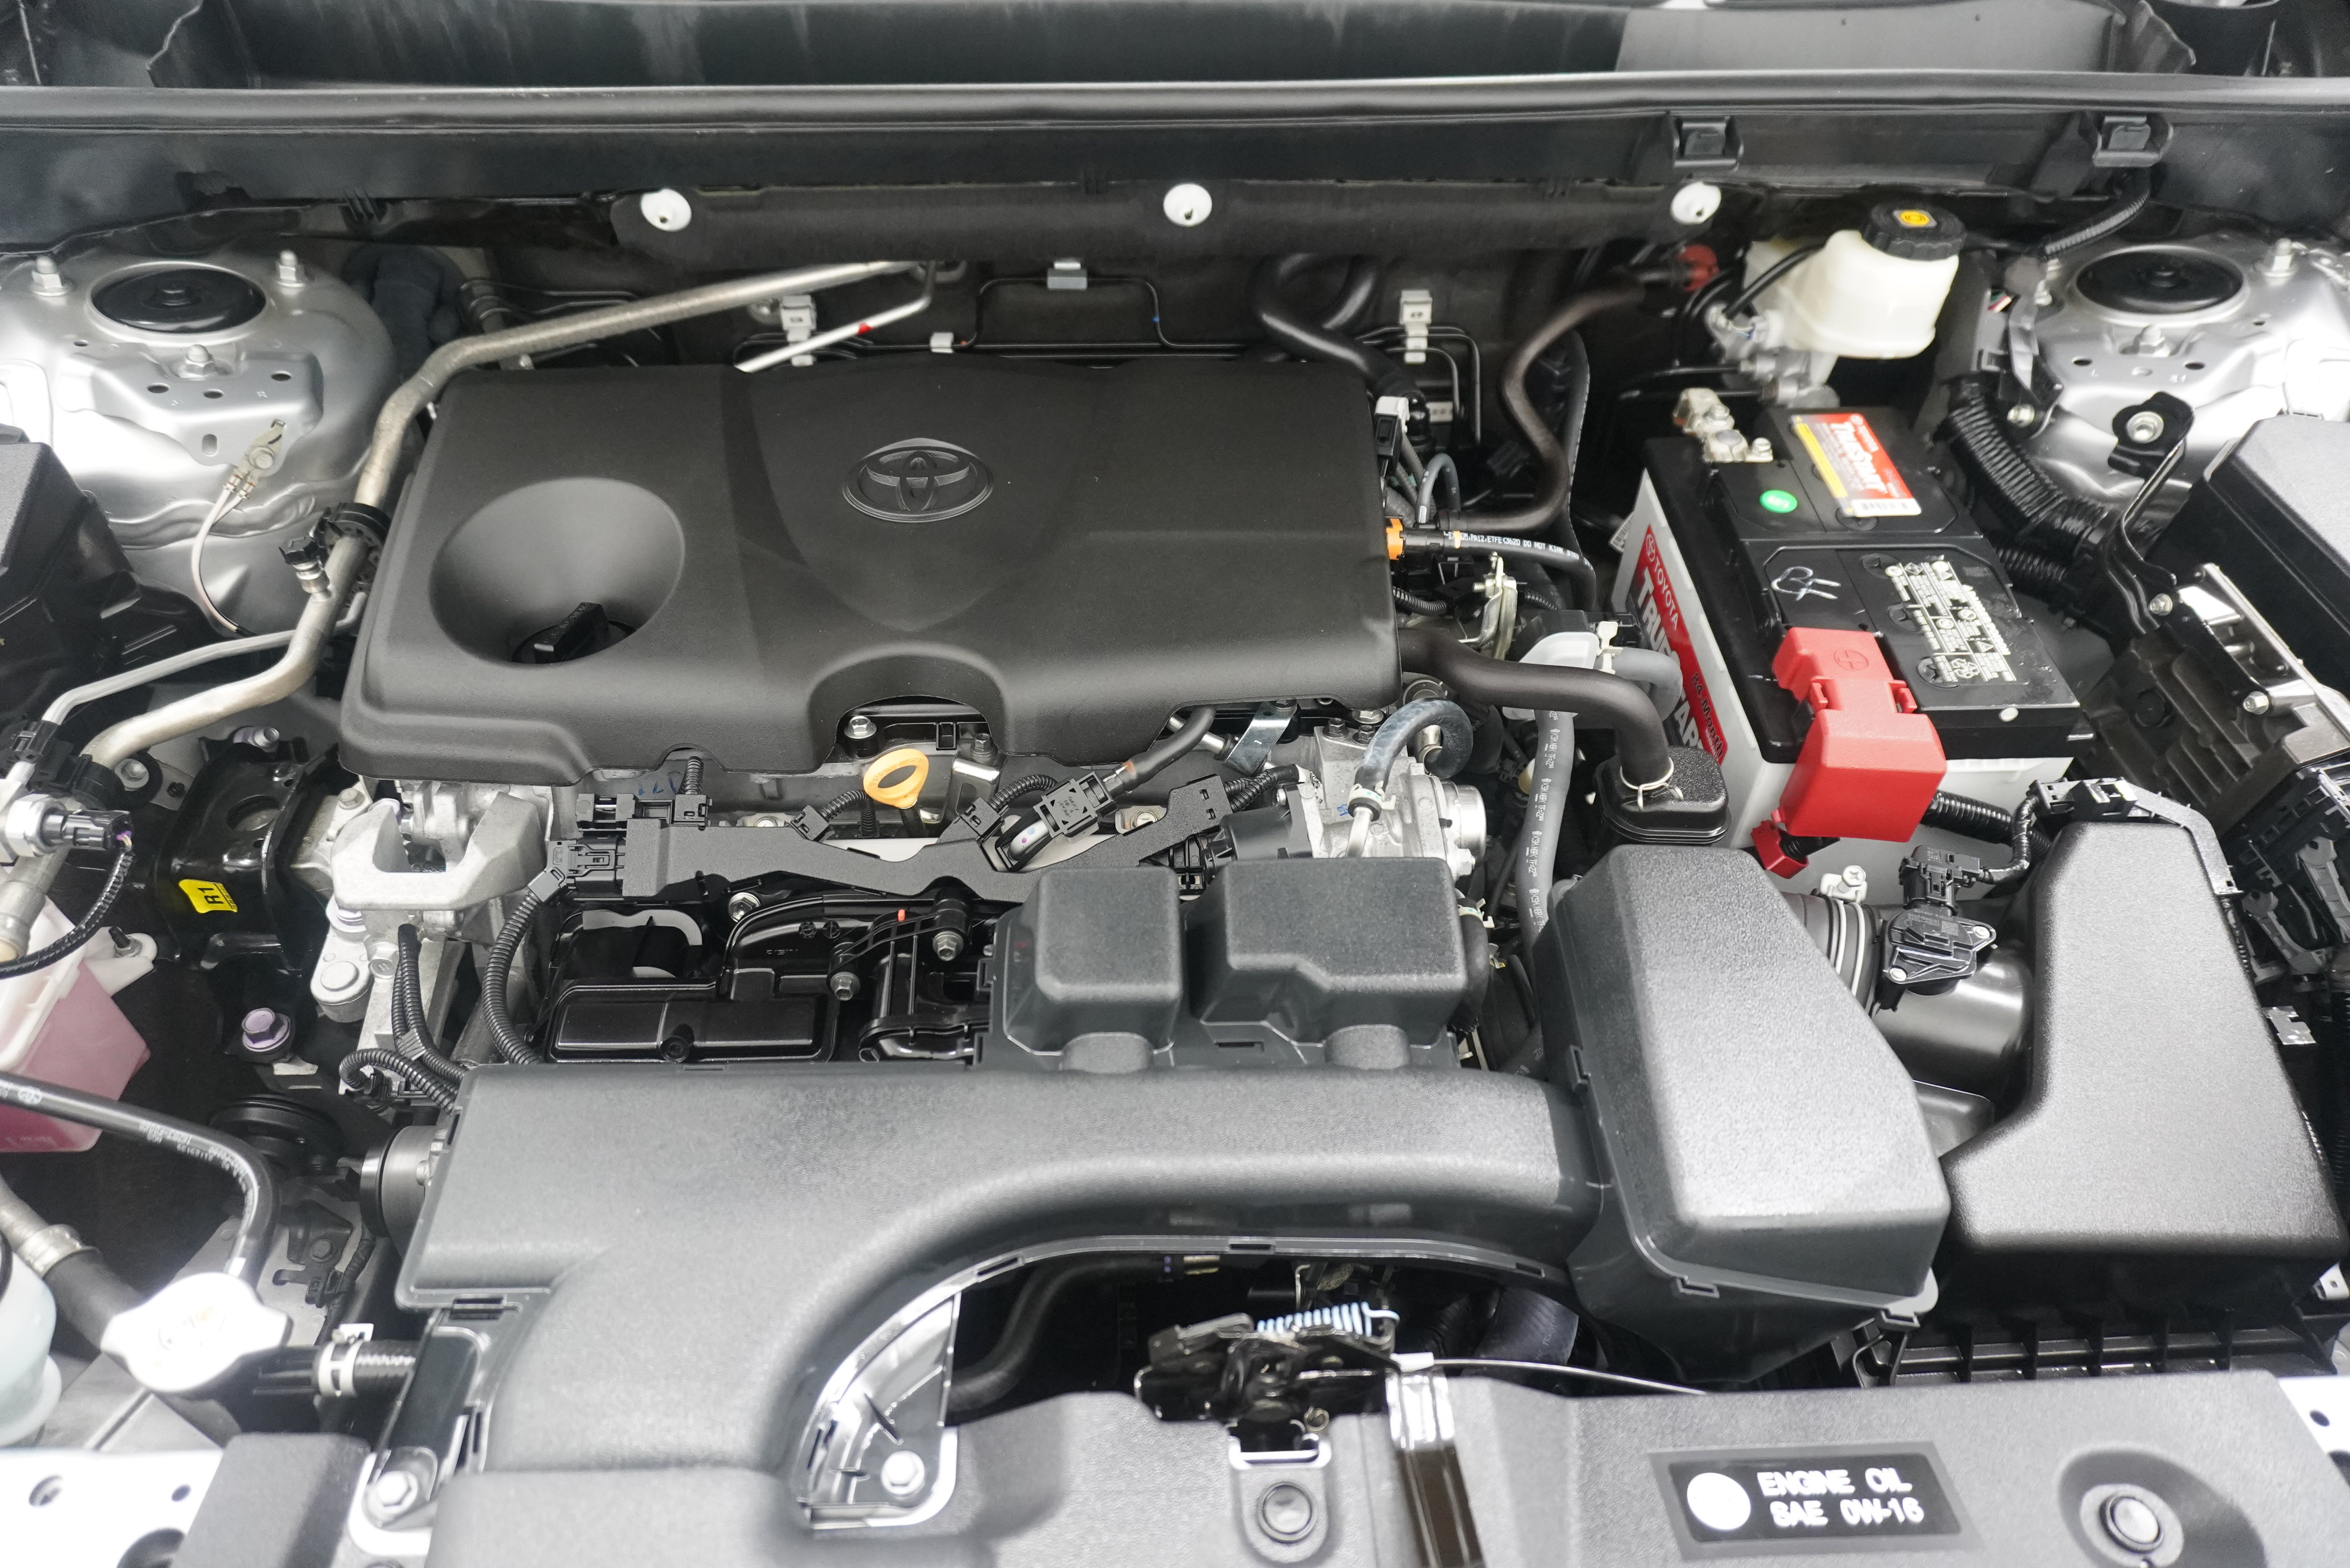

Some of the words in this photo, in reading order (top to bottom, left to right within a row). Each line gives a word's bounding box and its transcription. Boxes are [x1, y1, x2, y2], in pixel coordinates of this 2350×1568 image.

[1534, 541, 1546, 550] NOT
[1549, 544, 1564, 555] KINK
[1653, 557, 1678, 631] TOYOTA
[197, 887, 224, 904] R1
[1756, 1470, 1855, 1497] ENGINE
[1864, 1467, 1913, 1493] OIL
[1770, 1501, 1828, 1528] SAE
[1840, 1496, 1925, 1528] 0W-16
